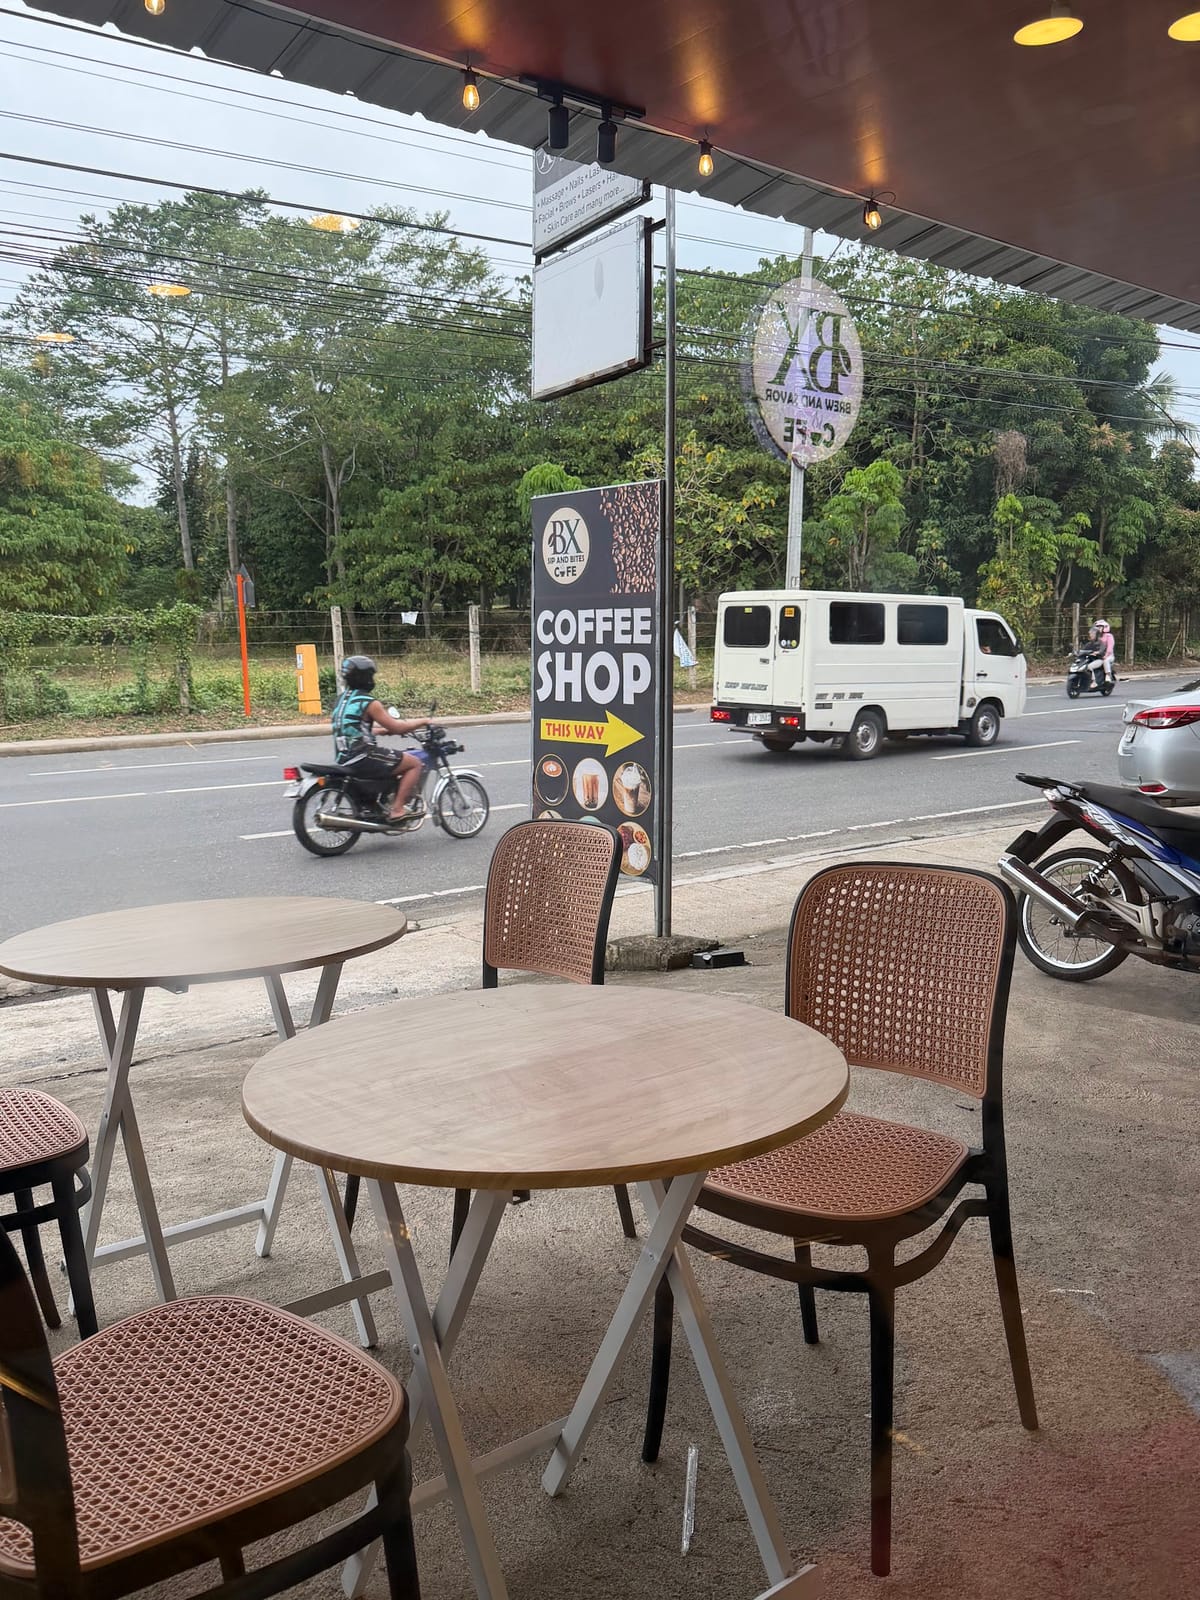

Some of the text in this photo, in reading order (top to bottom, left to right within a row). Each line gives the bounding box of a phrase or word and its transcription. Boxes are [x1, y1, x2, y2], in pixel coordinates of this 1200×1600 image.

[538, 207, 555, 224] Facial
[559, 196, 577, 212] Brows
[581, 182, 601, 199] Lasers
[540, 187, 565, 208] Massage
[569, 175, 584, 191] Nails
[547, 219, 560, 234] Skin
[560, 211, 574, 226] Care
[573, 207, 585, 221] and
[586, 198, 602, 211] many
[547, 518, 585, 555] BX
[554, 566, 577, 577] CFE
[556, 555, 569, 564] AND
[569, 554, 585, 563] BITES
[536, 607, 652, 645] COFFEE
[536, 650, 652, 705] SHOP
[545, 722, 605, 740] THIS WAY
